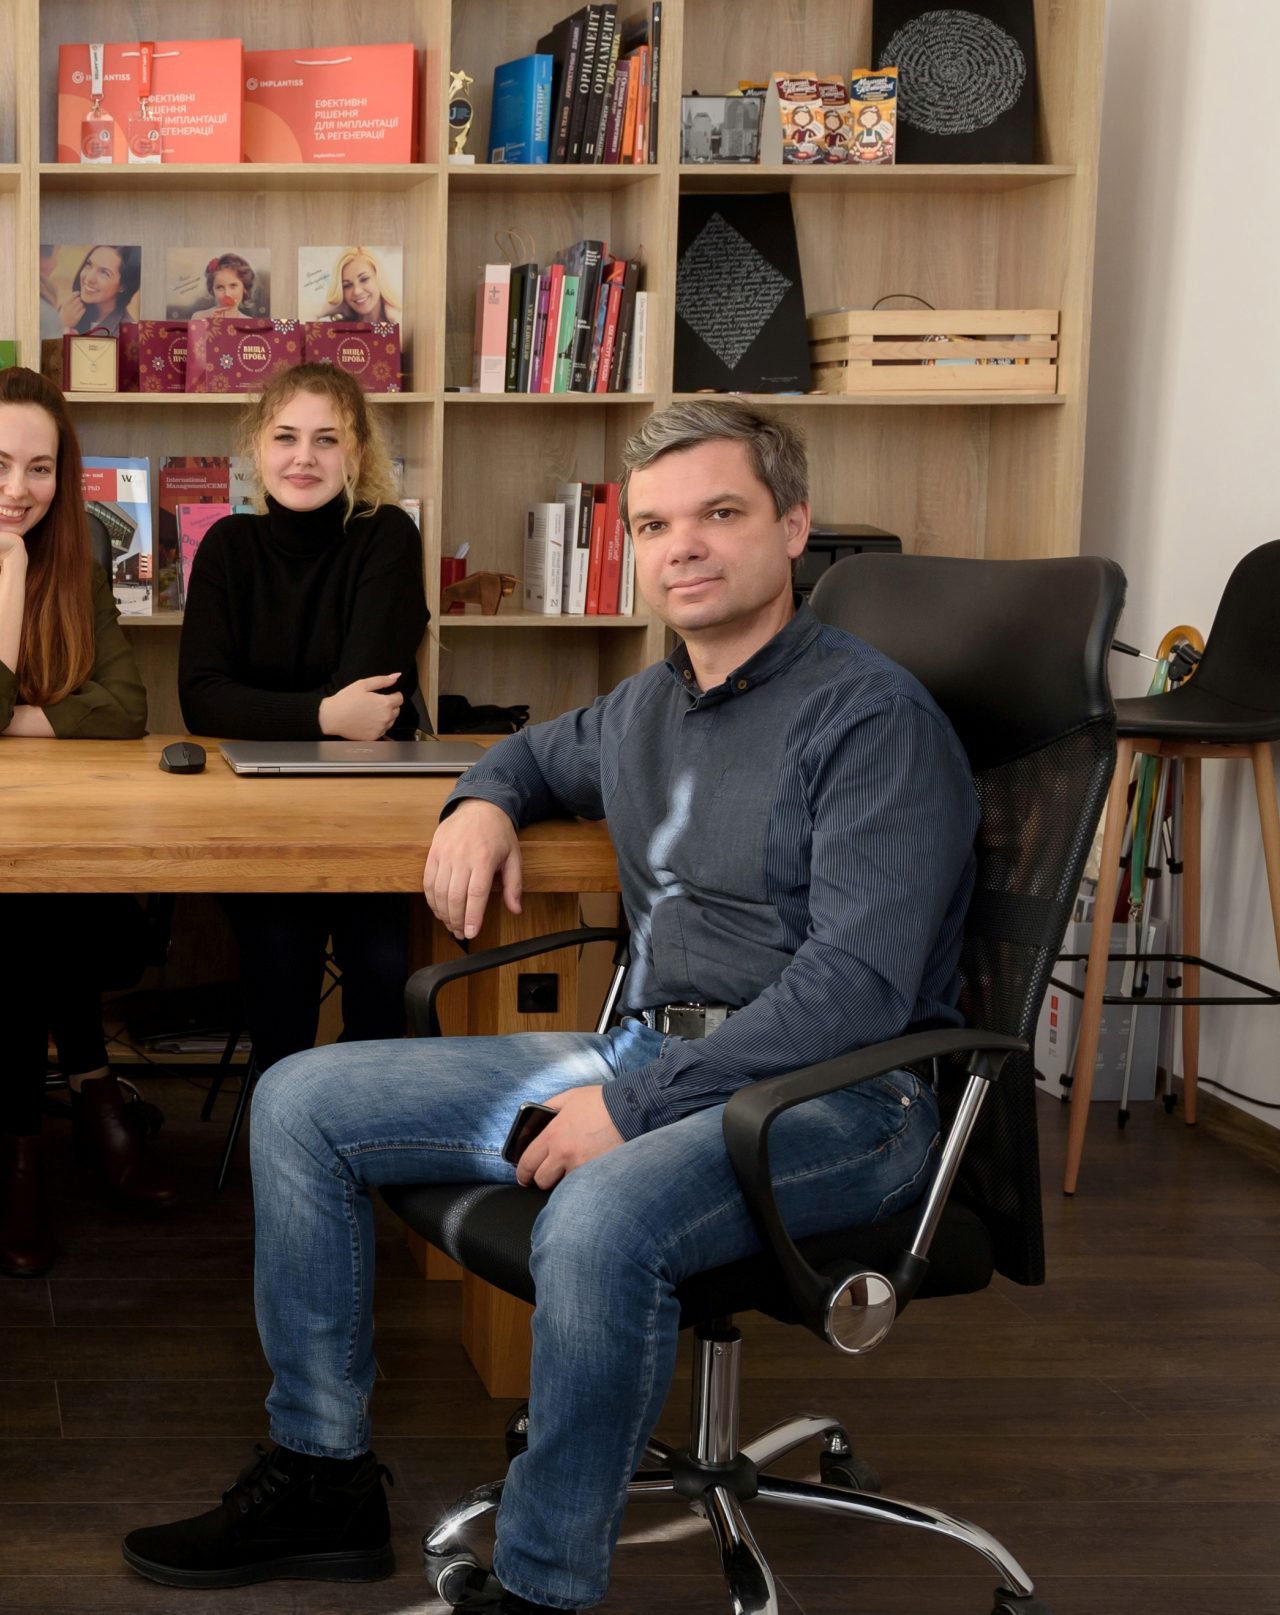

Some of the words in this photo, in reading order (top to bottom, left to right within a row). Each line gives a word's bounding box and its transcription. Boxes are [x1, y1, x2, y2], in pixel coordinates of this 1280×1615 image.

[579, 11, 600, 94] ОРНАМЕНТ
[594, 11, 616, 94] ОРНАМЕНТ
[260, 79, 304, 87] IMPLANTISS
[144, 93, 196, 103] ФЕКТИВНІ
[314, 98, 368, 108] ЕФЕКТИВНІ
[314, 109, 359, 119] РІШЕННЯ
[314, 121, 335, 131] ДЛЯ
[336, 118, 399, 129] ІМПЛАНТАЦІЇ
[160, 126, 214, 136] ЕГЕНЕРАЦІЇ
[314, 132, 326, 141] ТА
[327, 130, 385, 141] РЕГЕНЕРАЦІЇ
[243, 345, 265, 353] ВИЩА
[342, 348, 365, 356] ВИЩА
